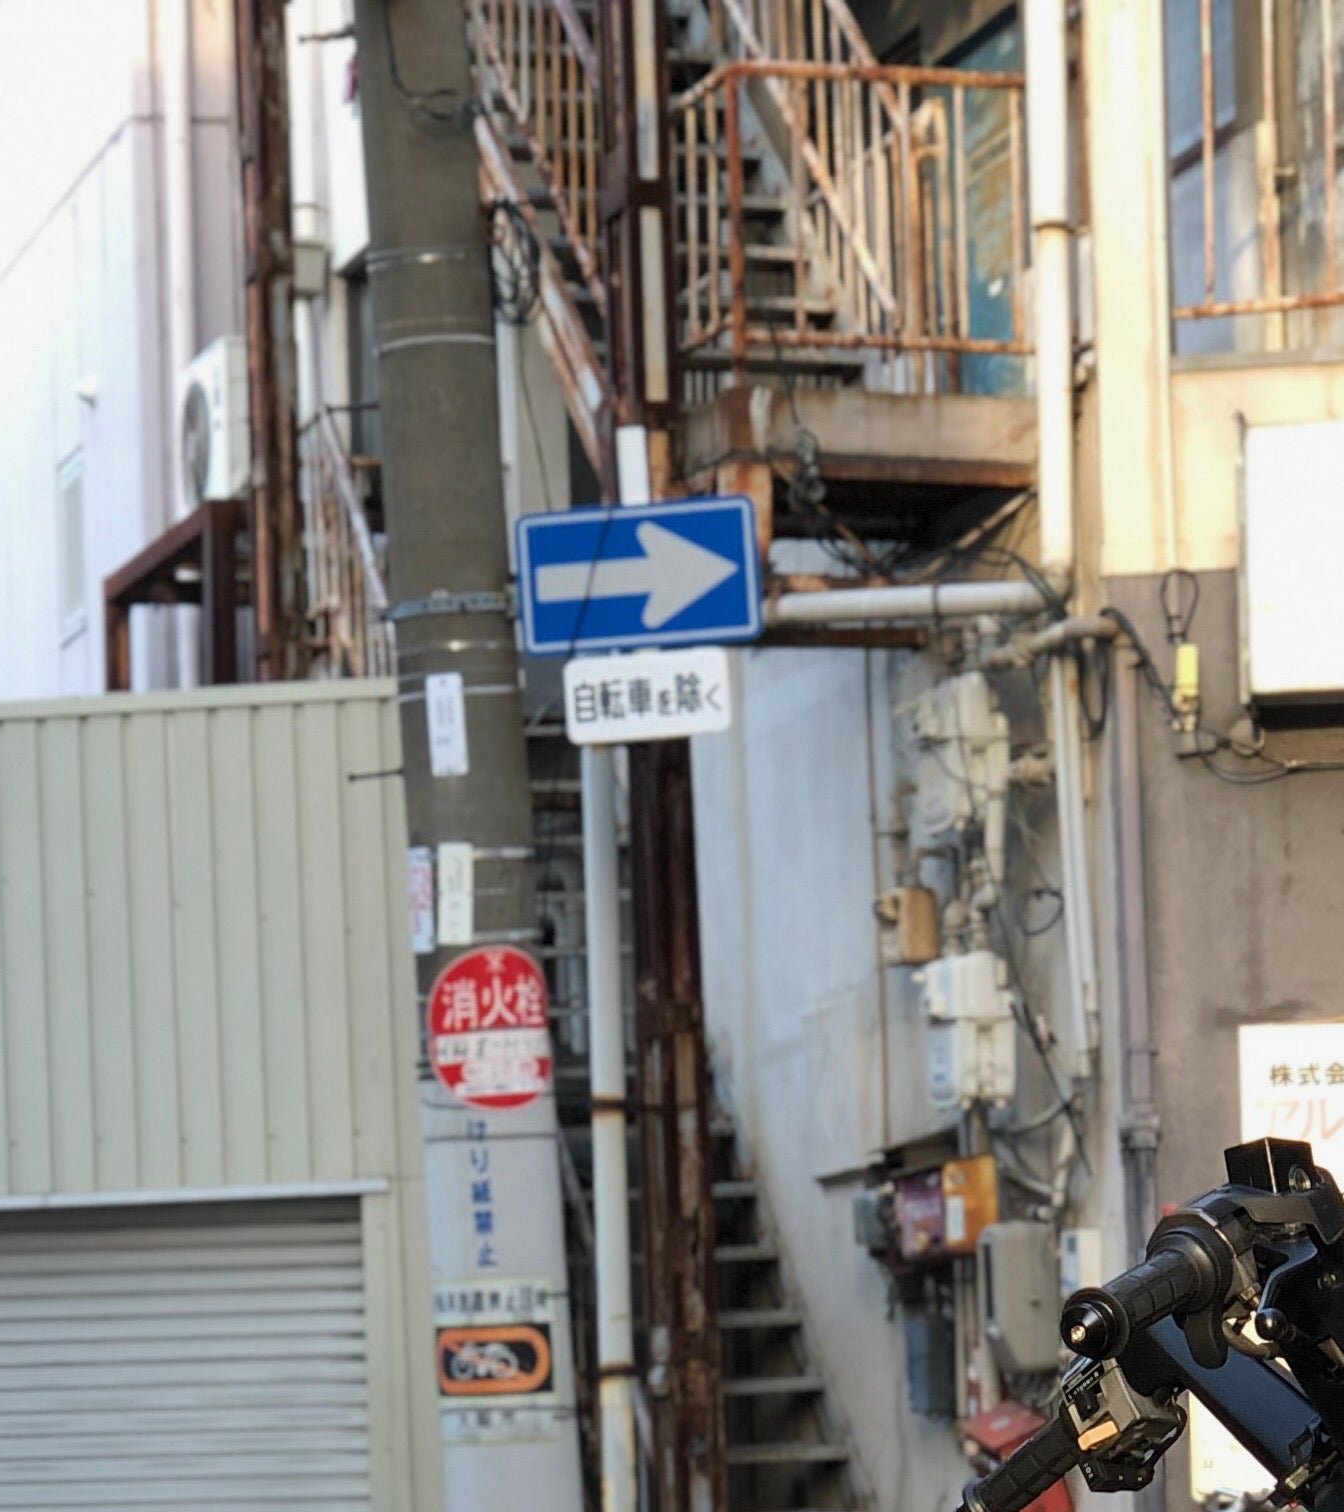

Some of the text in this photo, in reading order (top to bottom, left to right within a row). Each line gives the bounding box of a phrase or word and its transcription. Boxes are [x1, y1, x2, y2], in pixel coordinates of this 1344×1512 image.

[574, 672, 722, 723] 自転車を除く
[440, 970, 544, 1030] 消火栓
